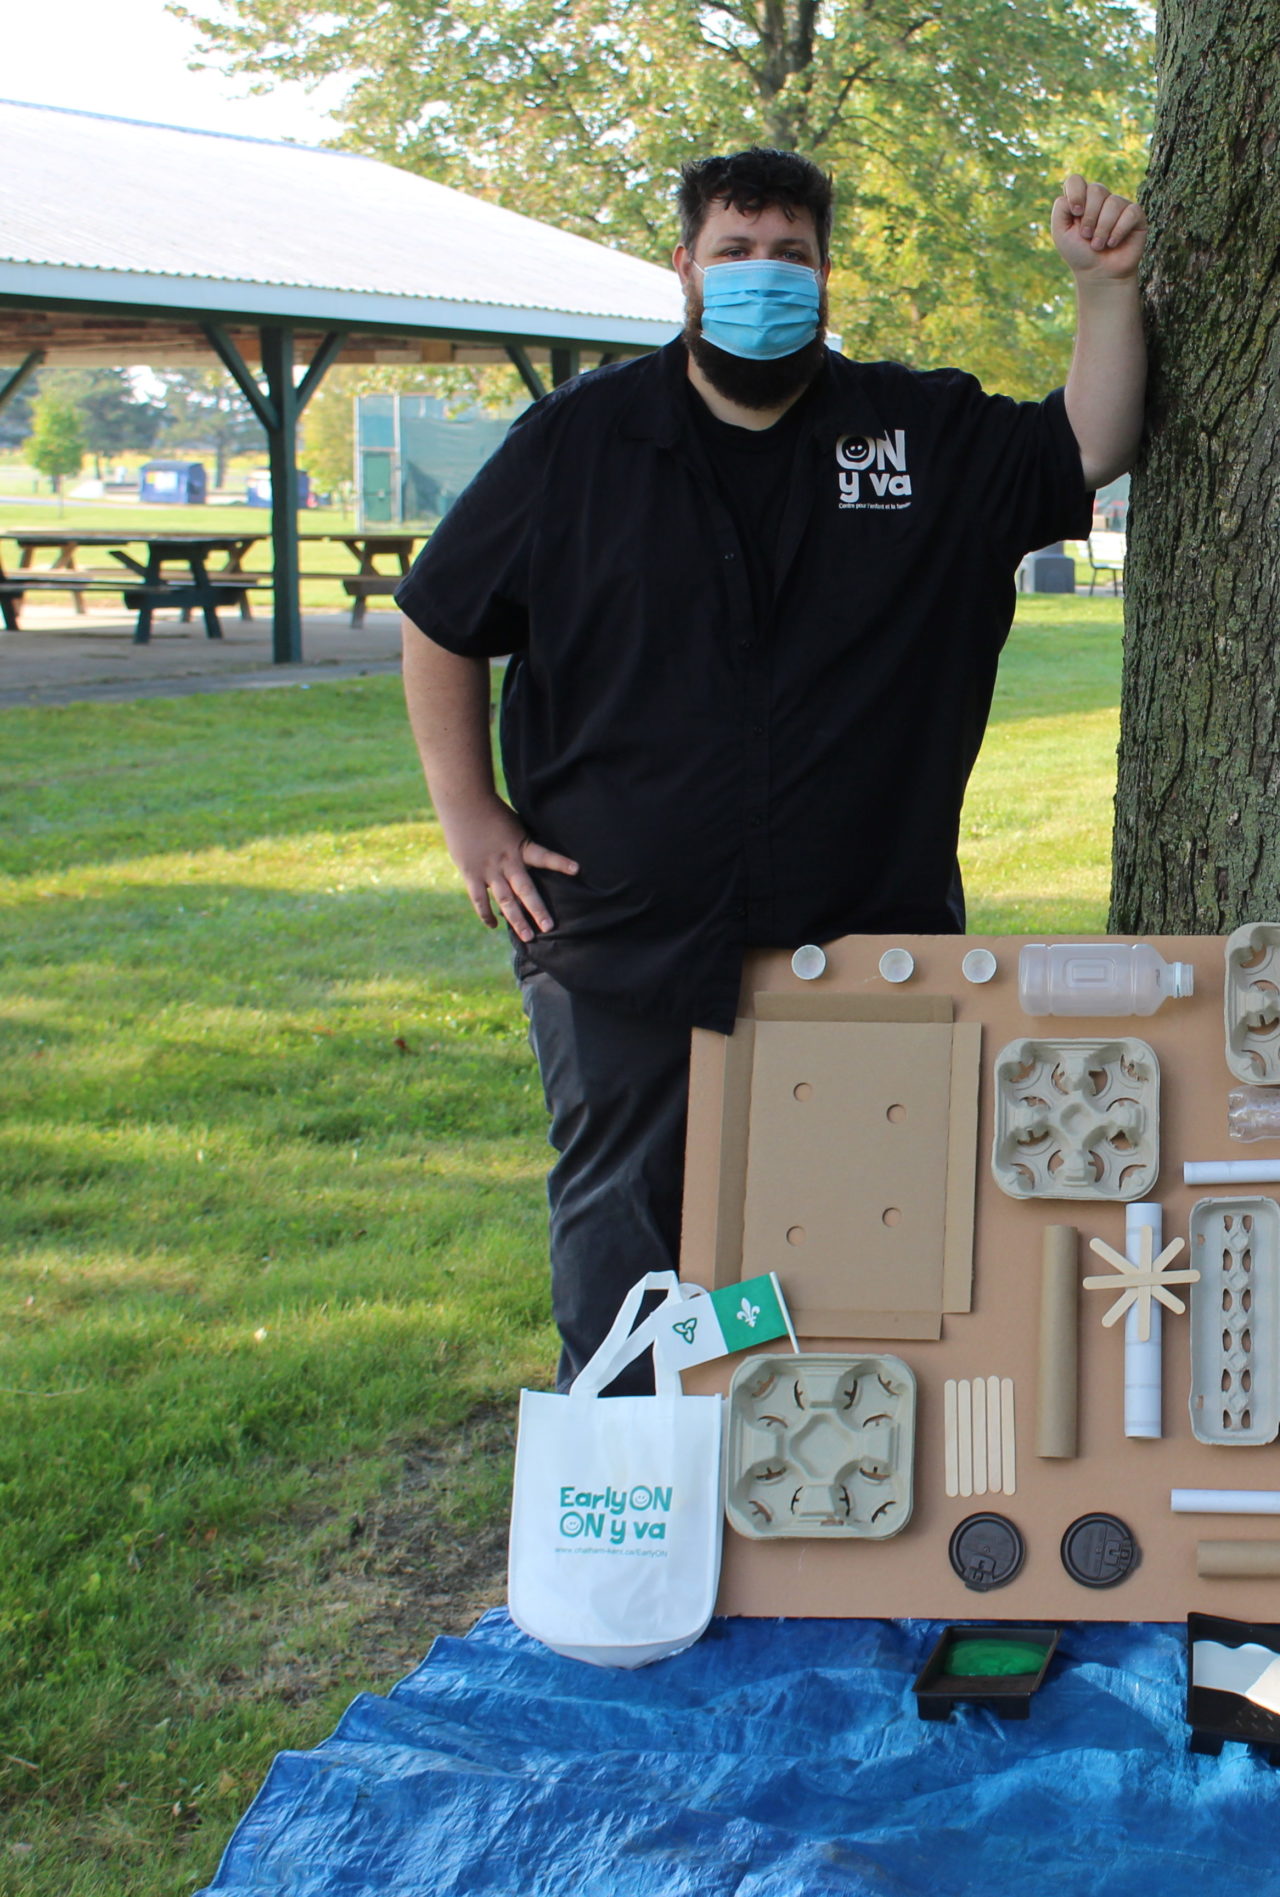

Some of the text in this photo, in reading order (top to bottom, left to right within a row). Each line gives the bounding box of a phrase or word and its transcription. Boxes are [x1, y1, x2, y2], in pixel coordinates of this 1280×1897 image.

[836, 429, 906, 471] ON
[839, 472, 912, 503] y va
[559, 1511, 667, 1545] ON y va
